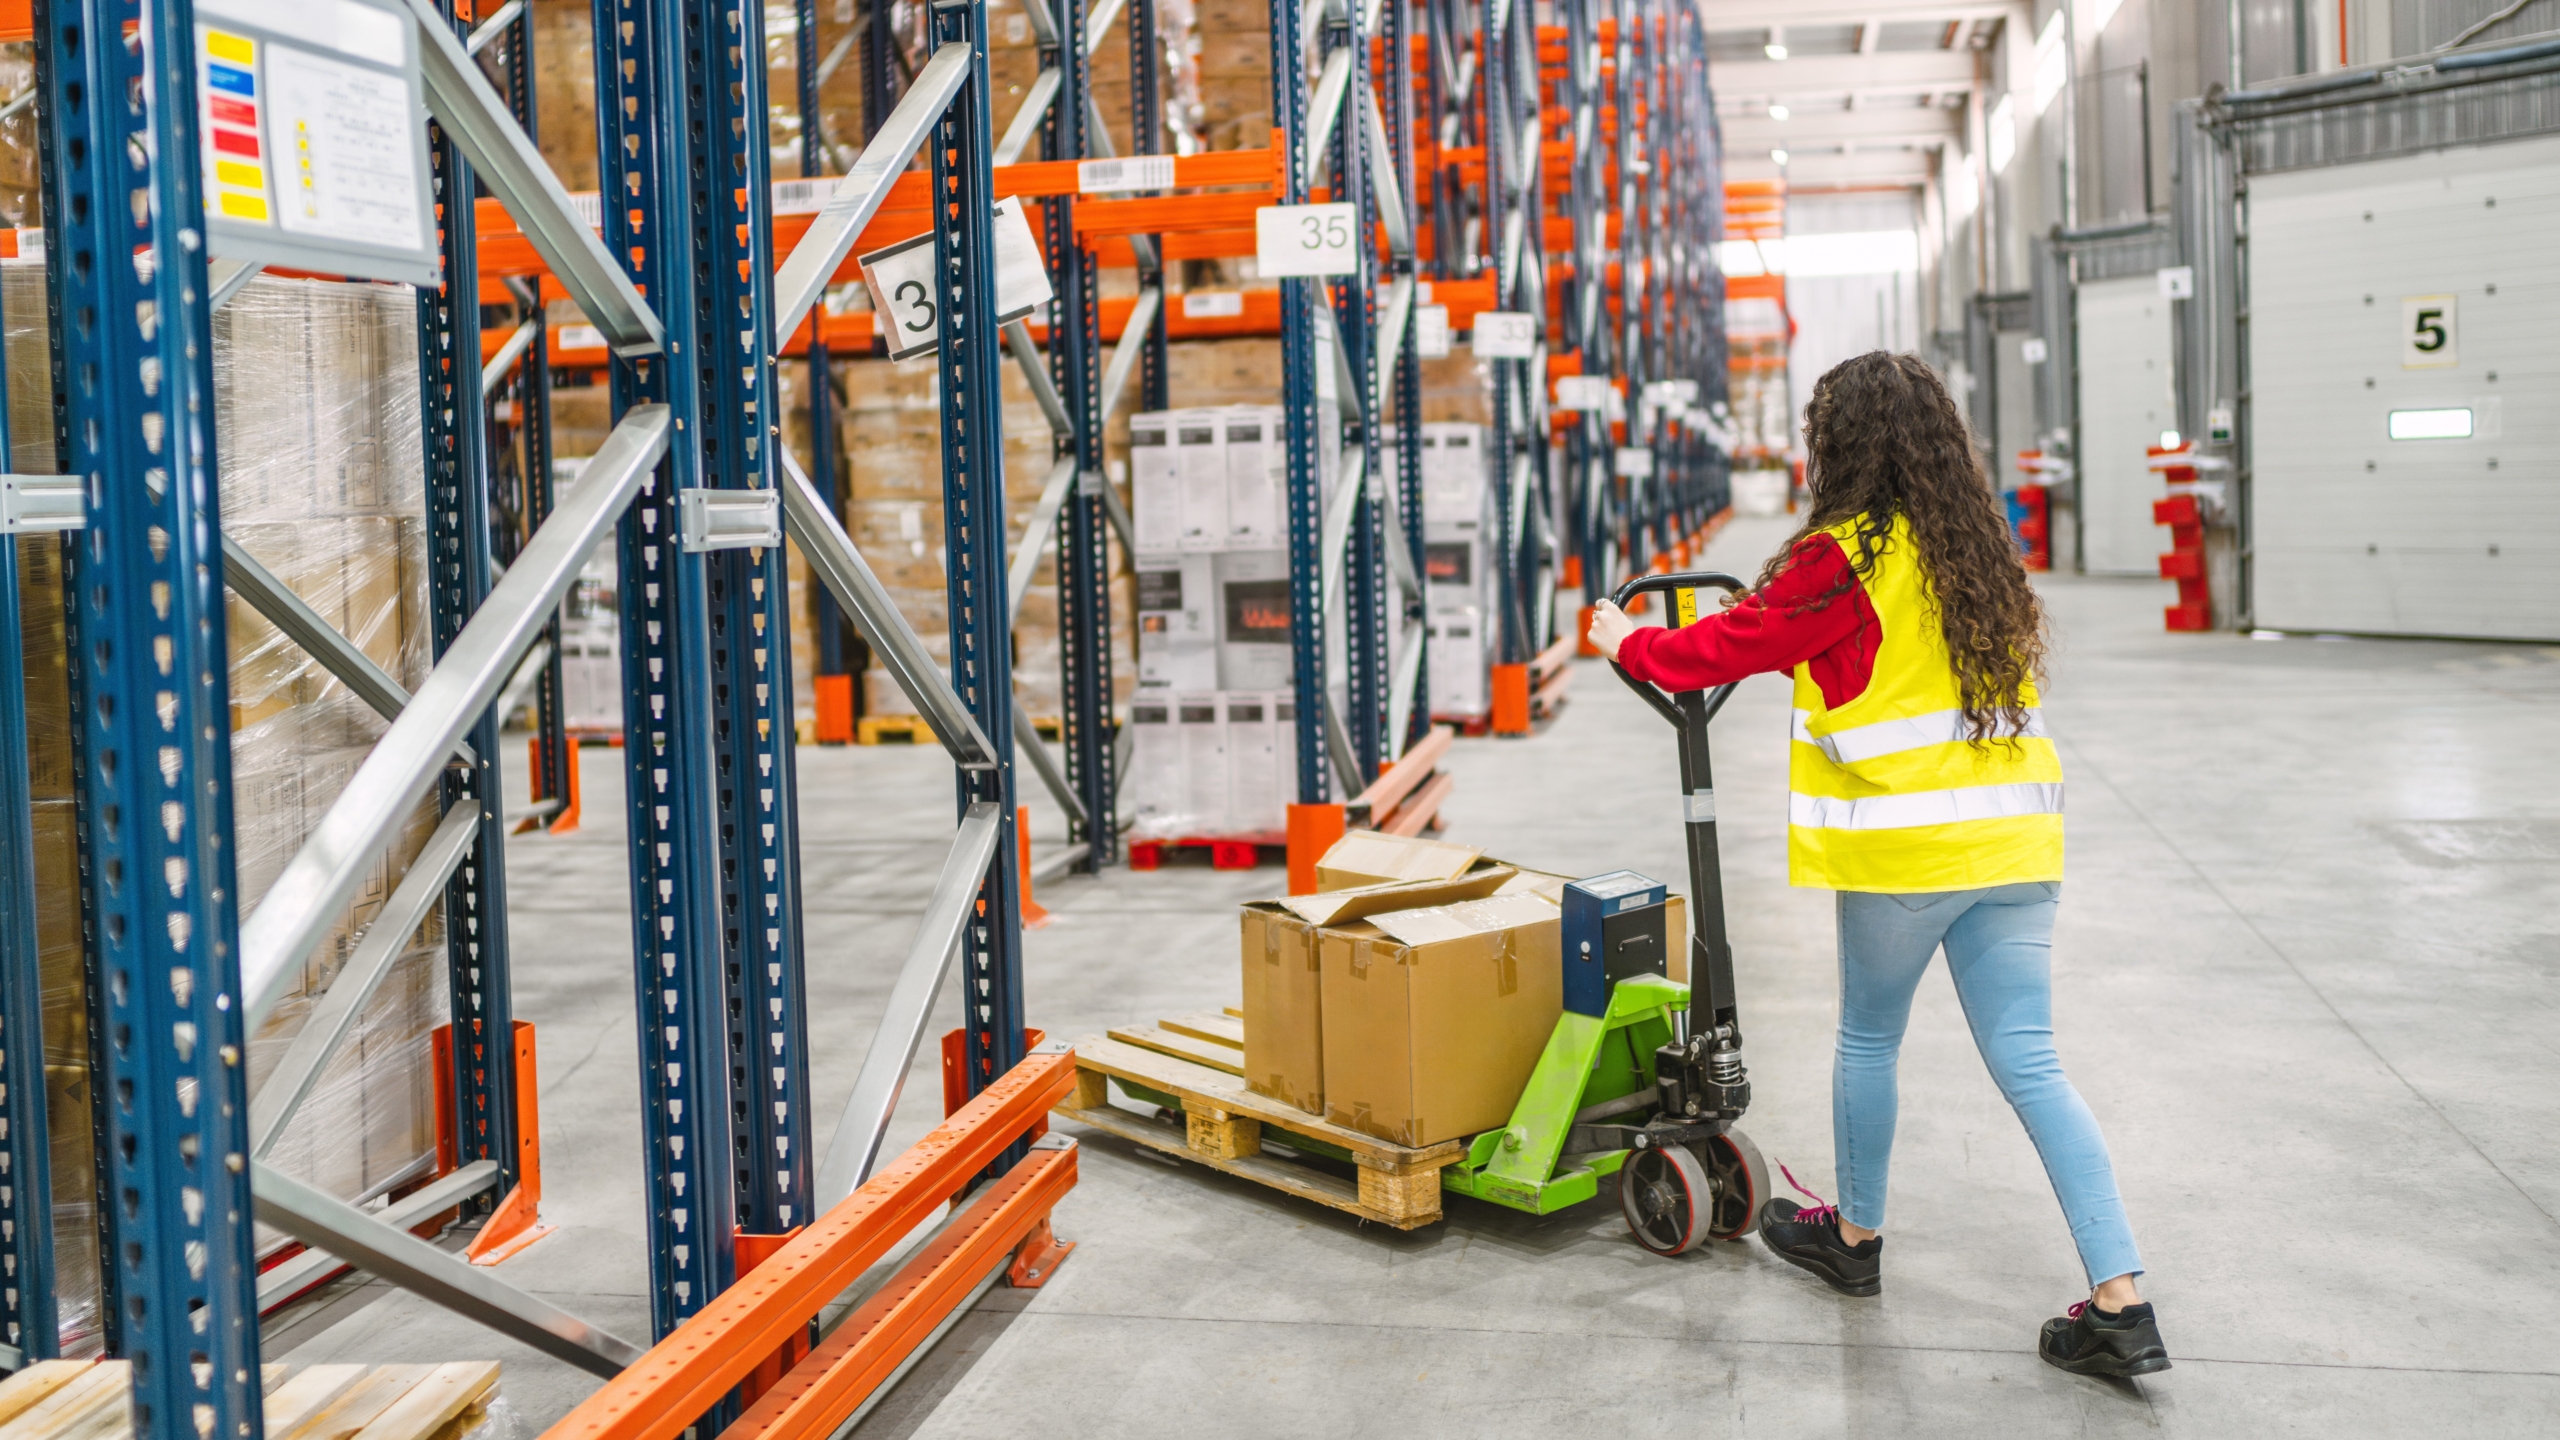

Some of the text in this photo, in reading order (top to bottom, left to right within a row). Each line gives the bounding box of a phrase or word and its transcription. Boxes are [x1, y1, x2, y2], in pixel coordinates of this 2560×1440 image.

[1301, 216, 1347, 250] 35
[1501, 321, 1529, 341] 33
[2414, 309, 2446, 352] 5
